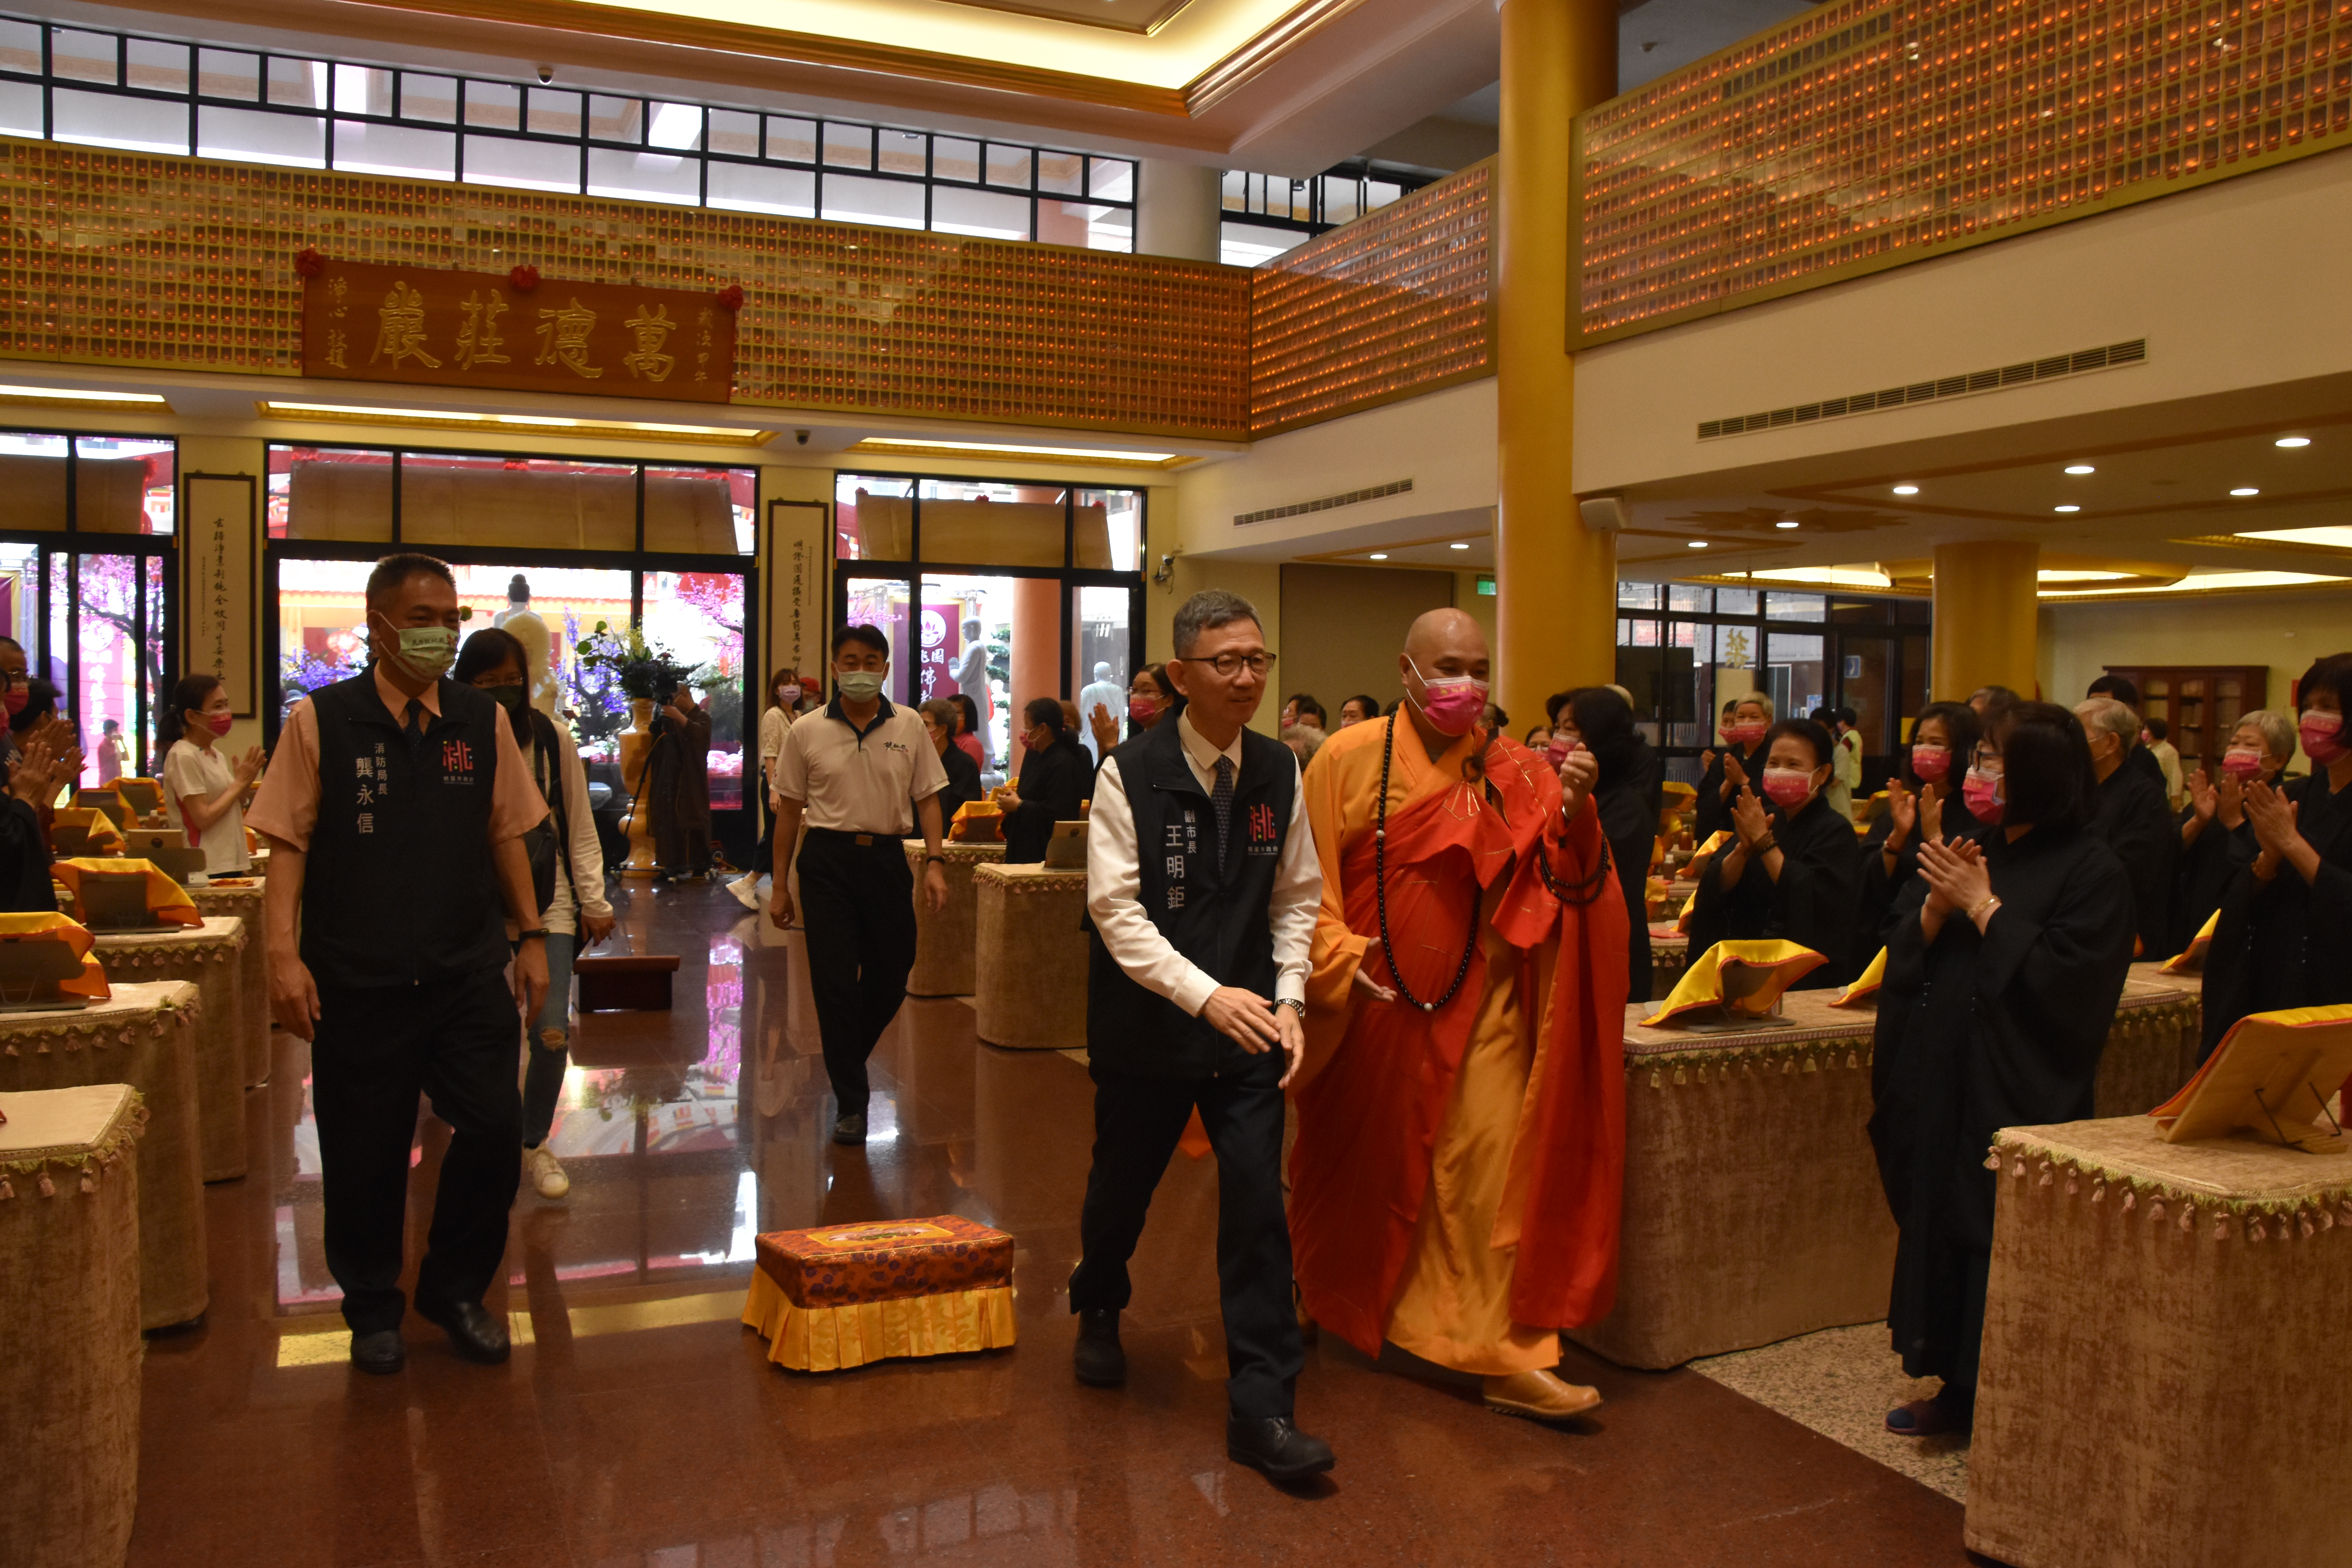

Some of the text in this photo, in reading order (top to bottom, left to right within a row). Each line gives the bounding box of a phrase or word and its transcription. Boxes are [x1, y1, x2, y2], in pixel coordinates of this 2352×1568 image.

[356, 757, 374, 834] 龔永信
[374, 742, 388, 795] 消防局長
[1183, 809, 1197, 854] 副市長
[1165, 825, 1185, 909] 王明鉅
